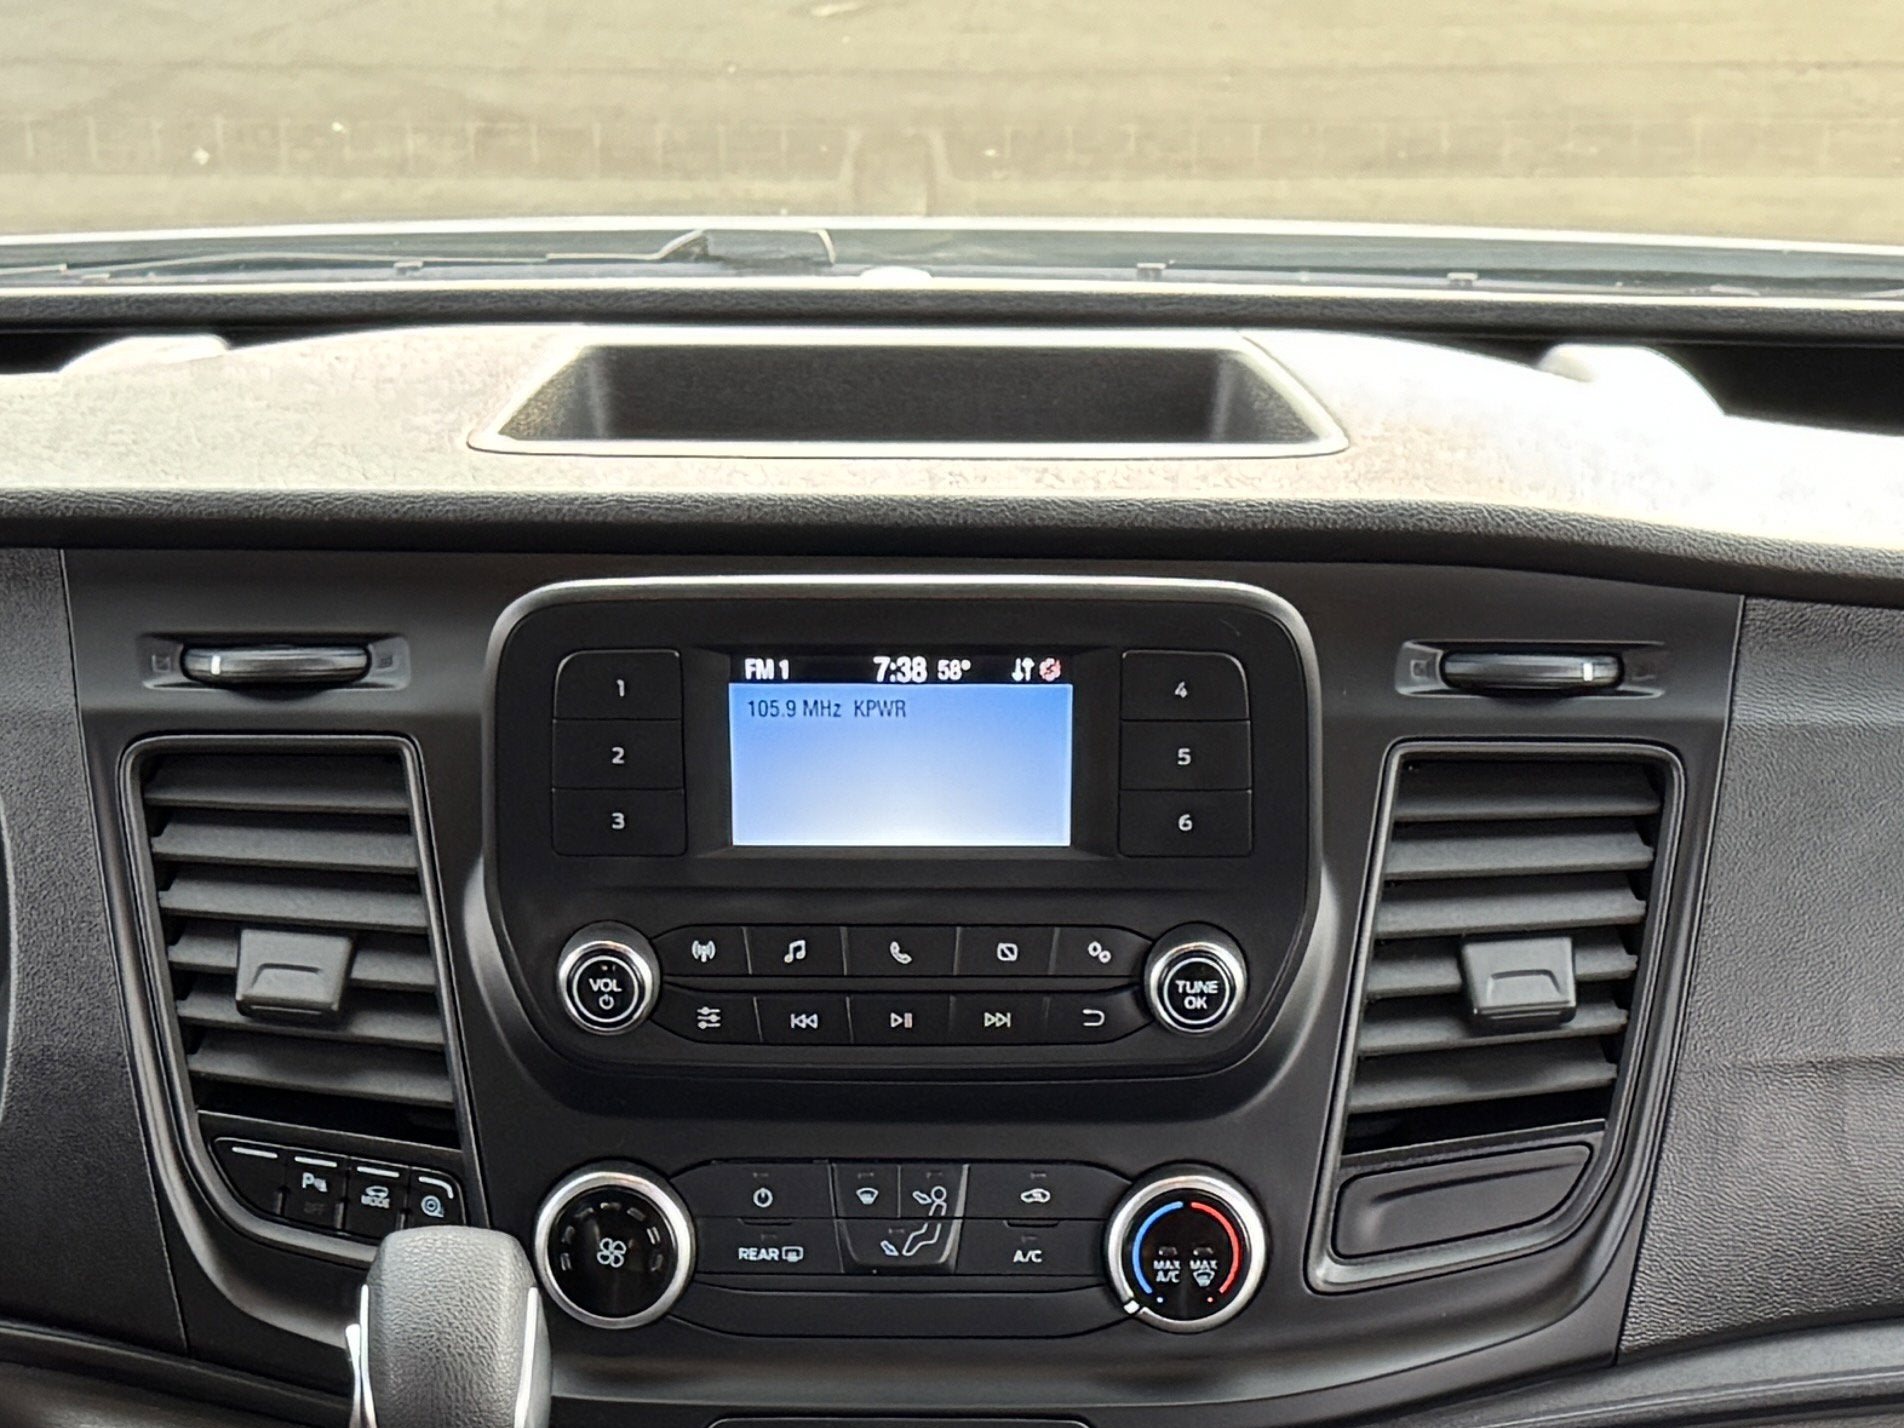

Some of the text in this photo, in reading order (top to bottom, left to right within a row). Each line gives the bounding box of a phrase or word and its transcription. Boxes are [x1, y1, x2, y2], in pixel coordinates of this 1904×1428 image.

[744, 658, 789, 680] FM 1
[873, 656, 928, 683] 7:38
[616, 679, 626, 697] 1
[1174, 681, 1188, 698] 4
[748, 699, 906, 718] 105.9 MHz KPWR
[611, 746, 625, 764] 2
[1177, 748, 1192, 765] 5
[611, 812, 626, 829] 3
[1178, 814, 1193, 831] 6
[589, 978, 622, 992] VOL
[1175, 980, 1218, 994] TUNE
[1184, 996, 1207, 1010] OK
[738, 1247, 780, 1262] REAR
[1013, 1248, 1043, 1264] A/C
[1153, 1259, 1181, 1270] MAX
[1190, 1259, 1218, 1270] MAX
[1156, 1270, 1181, 1283] A/C
